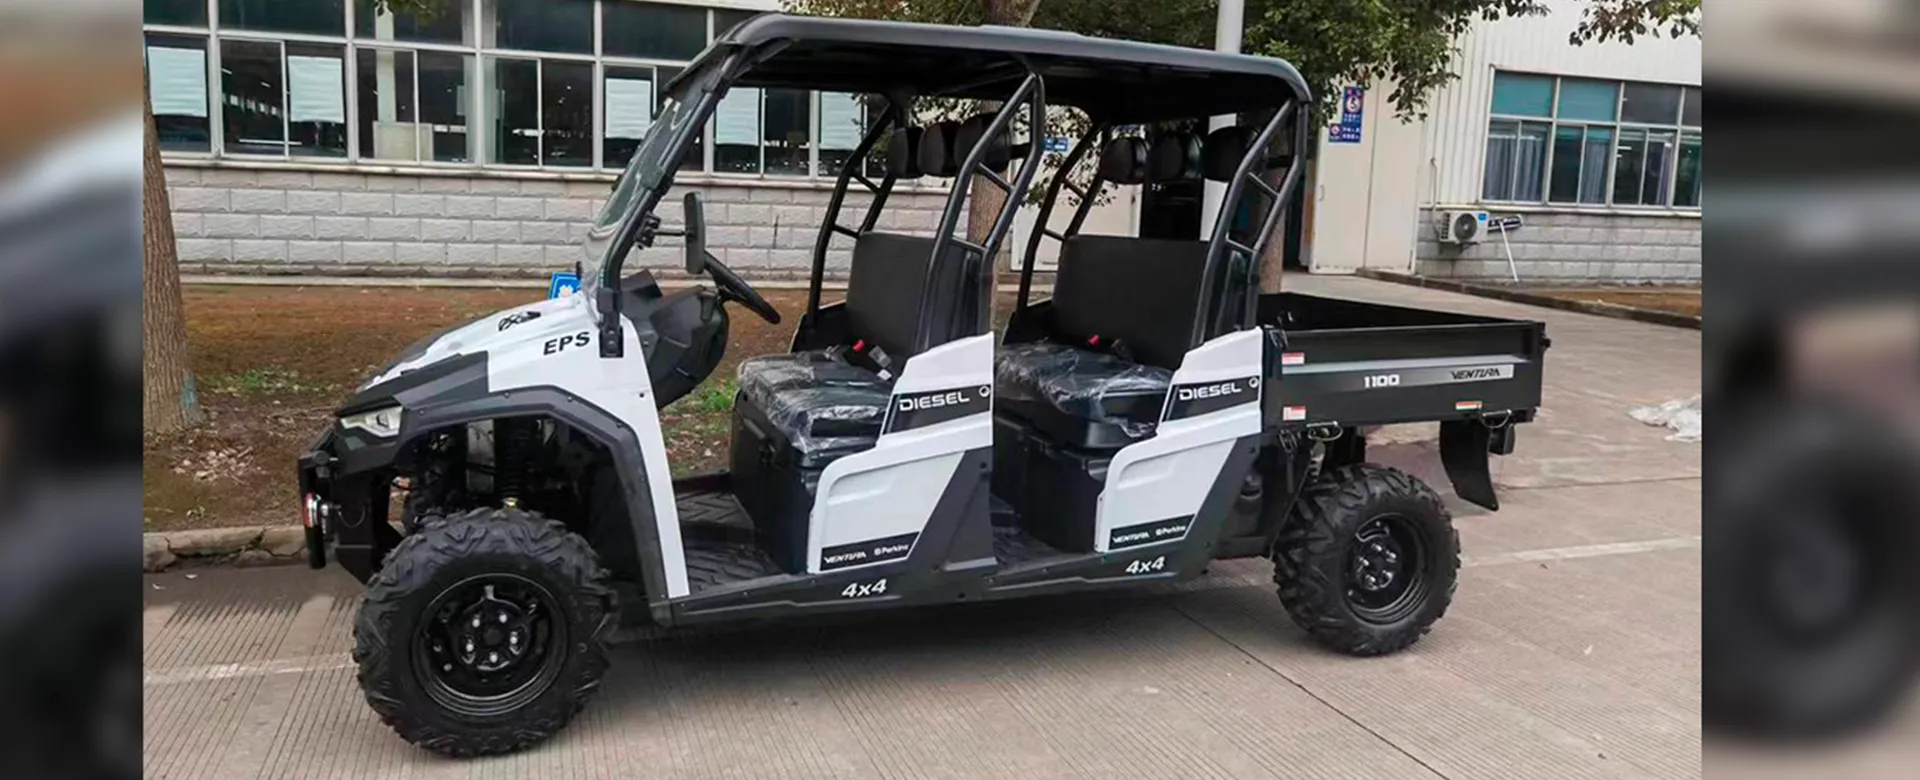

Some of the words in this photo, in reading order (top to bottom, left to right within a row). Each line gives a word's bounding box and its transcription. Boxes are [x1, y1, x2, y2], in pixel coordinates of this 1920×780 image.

[543, 332, 591, 356] EPS
[1364, 374, 1400, 388] 1100
[1451, 368, 1501, 380] VENTURA
[1179, 382, 1242, 401] DIESEL
[899, 391, 970, 412] DIESEL
[823, 551, 867, 564] VENTURA
[1125, 556, 1165, 574] 4x4
[841, 578, 887, 597] 4x4
